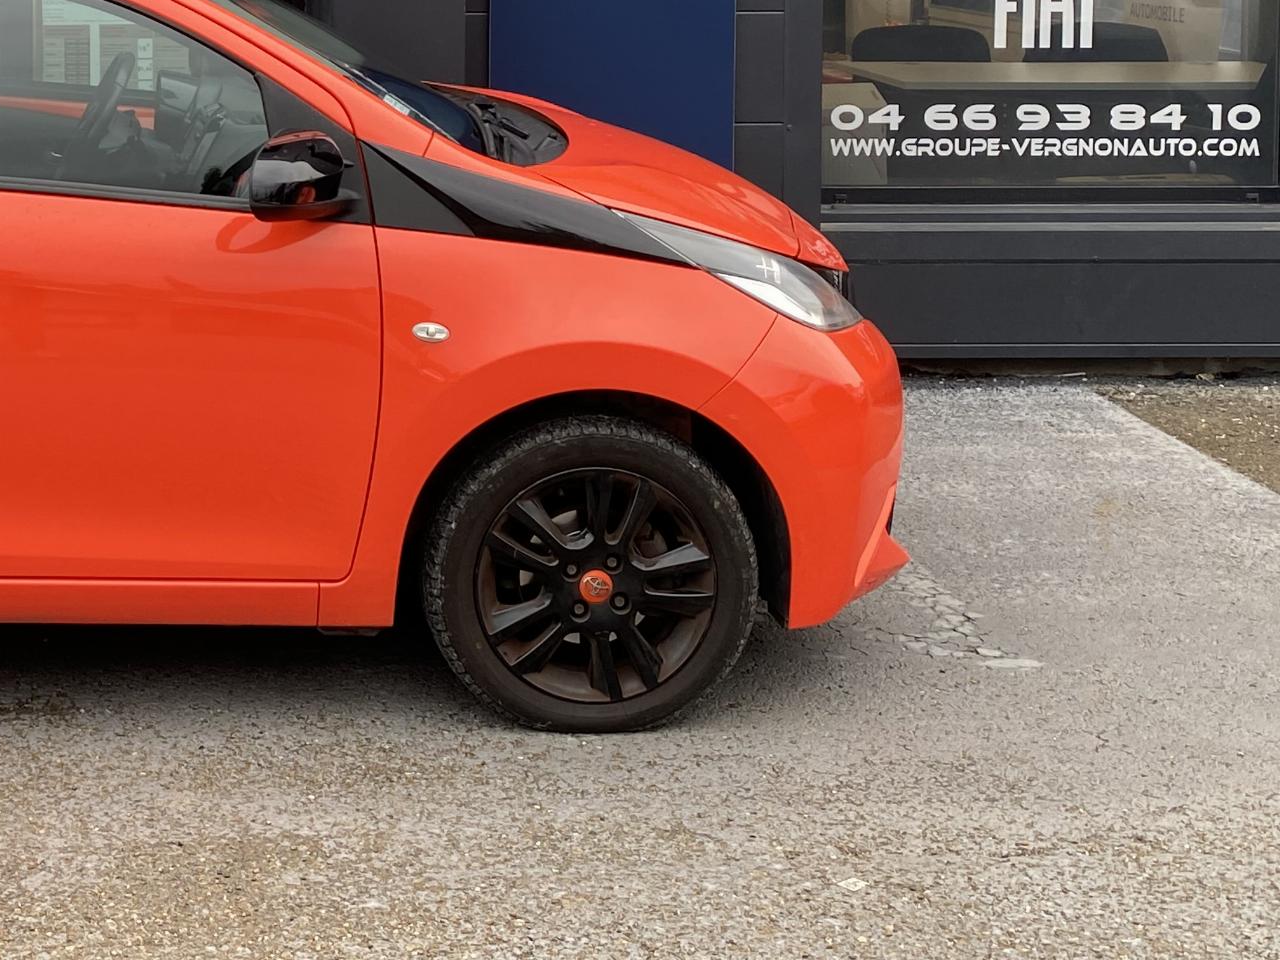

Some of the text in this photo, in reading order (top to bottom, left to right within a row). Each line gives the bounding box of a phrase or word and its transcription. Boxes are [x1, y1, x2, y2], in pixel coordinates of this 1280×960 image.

[1130, 4, 1185, 23] AUTOMOBILE
[829, 103, 1261, 131] 04 66 93 84 10
[830, 137, 1260, 157] WWW.GROUPE-VERGNONAUTO.COM
